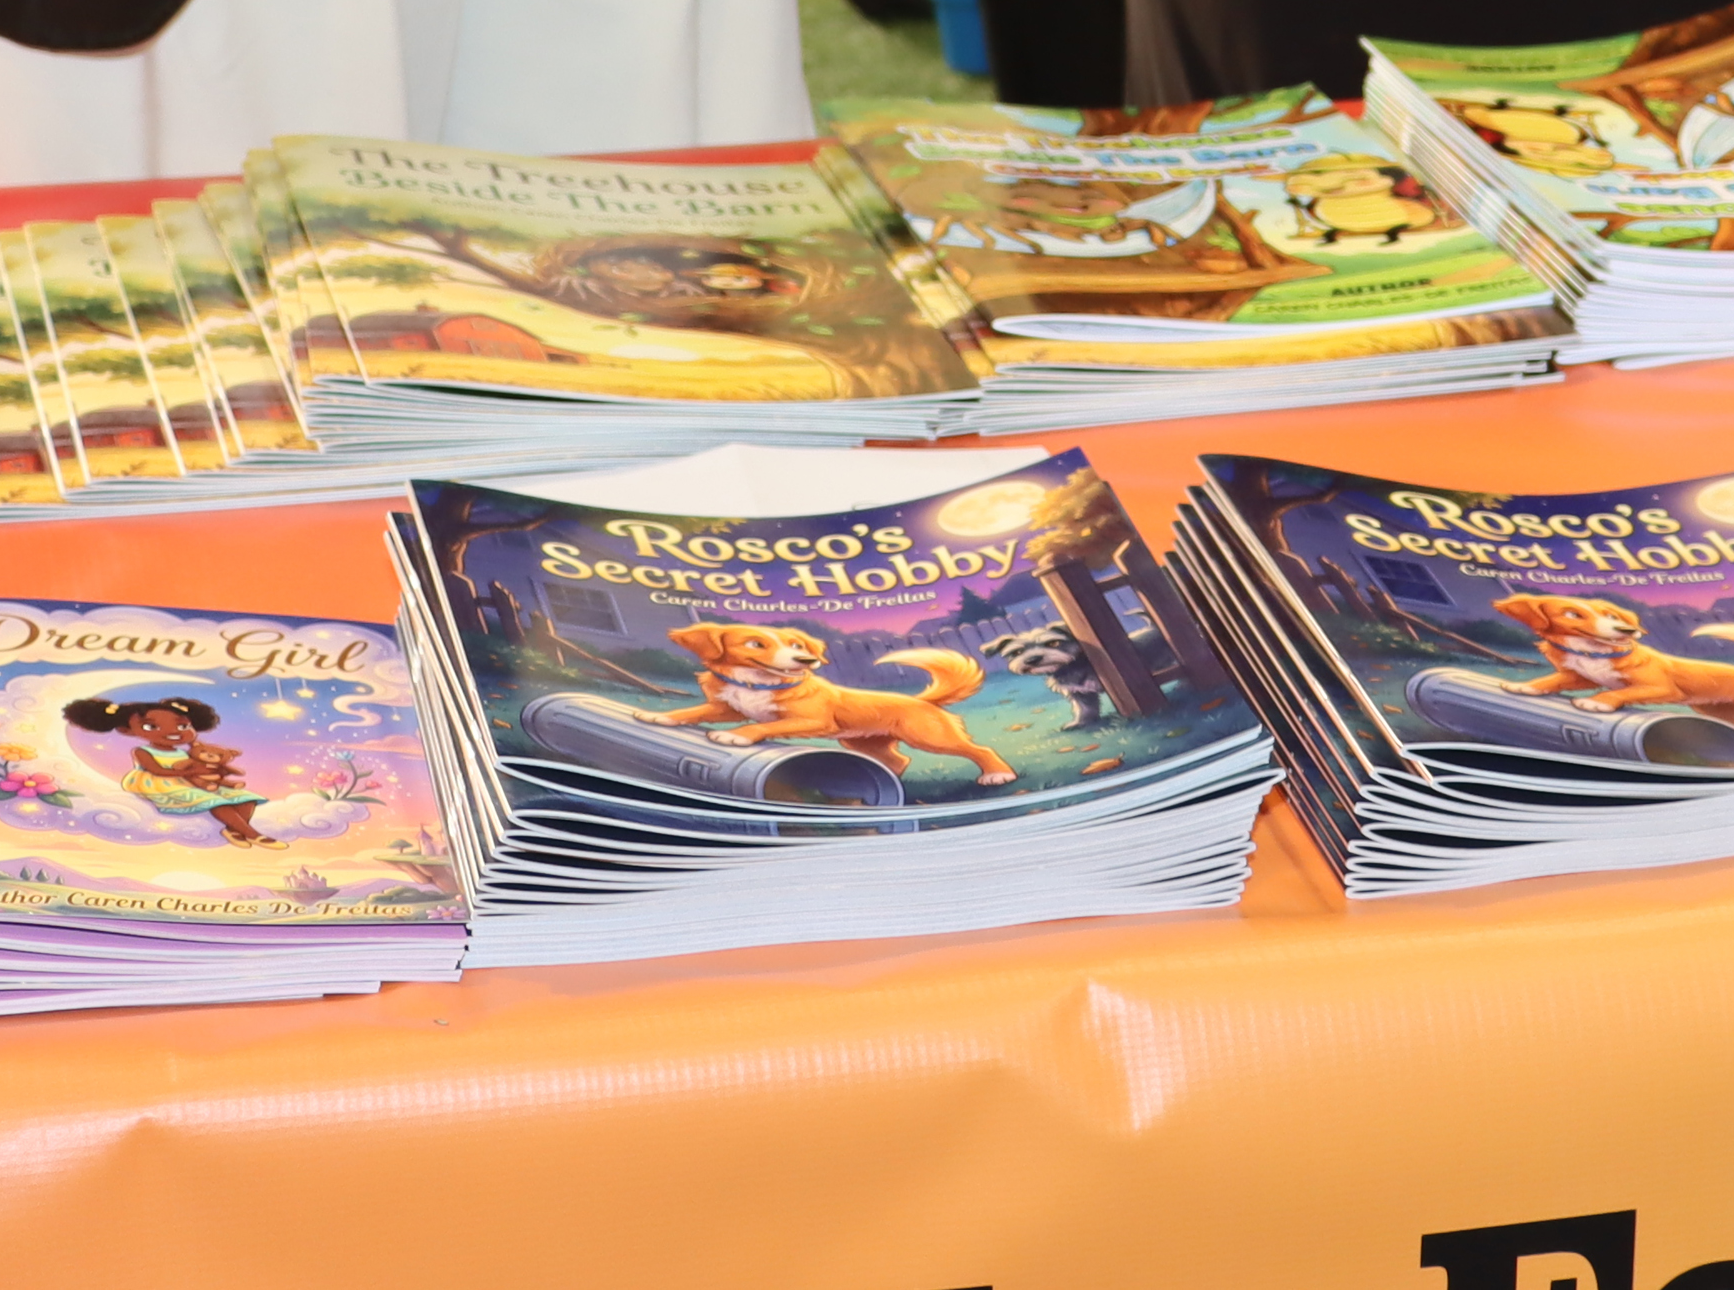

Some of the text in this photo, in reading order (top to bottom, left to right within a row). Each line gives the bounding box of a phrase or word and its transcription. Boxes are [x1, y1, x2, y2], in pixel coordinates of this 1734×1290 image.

[330, 145, 807, 197] The Treehouse
[340, 168, 536, 206] Beside
[548, 190, 659, 216] The
[673, 197, 826, 219] Barn
[1584, 180, 1720, 201] Barn
[1344, 512, 1566, 571] Secret
[1388, 490, 1681, 542] Rosco's
[540, 538, 1020, 598] Secret Hobby
[605, 518, 914, 568] Rosco's
[1458, 561, 1523, 583] Caren
[1650, 569, 1726, 586] Freitas
[649, 588, 937, 613] Caren Charles-De Freitas
[220, 628, 370, 679] Girl
[67, 891, 147, 911] Caren
[156, 896, 259, 916] Charles
[268, 900, 307, 917] De
[316, 901, 414, 917] Freitas
